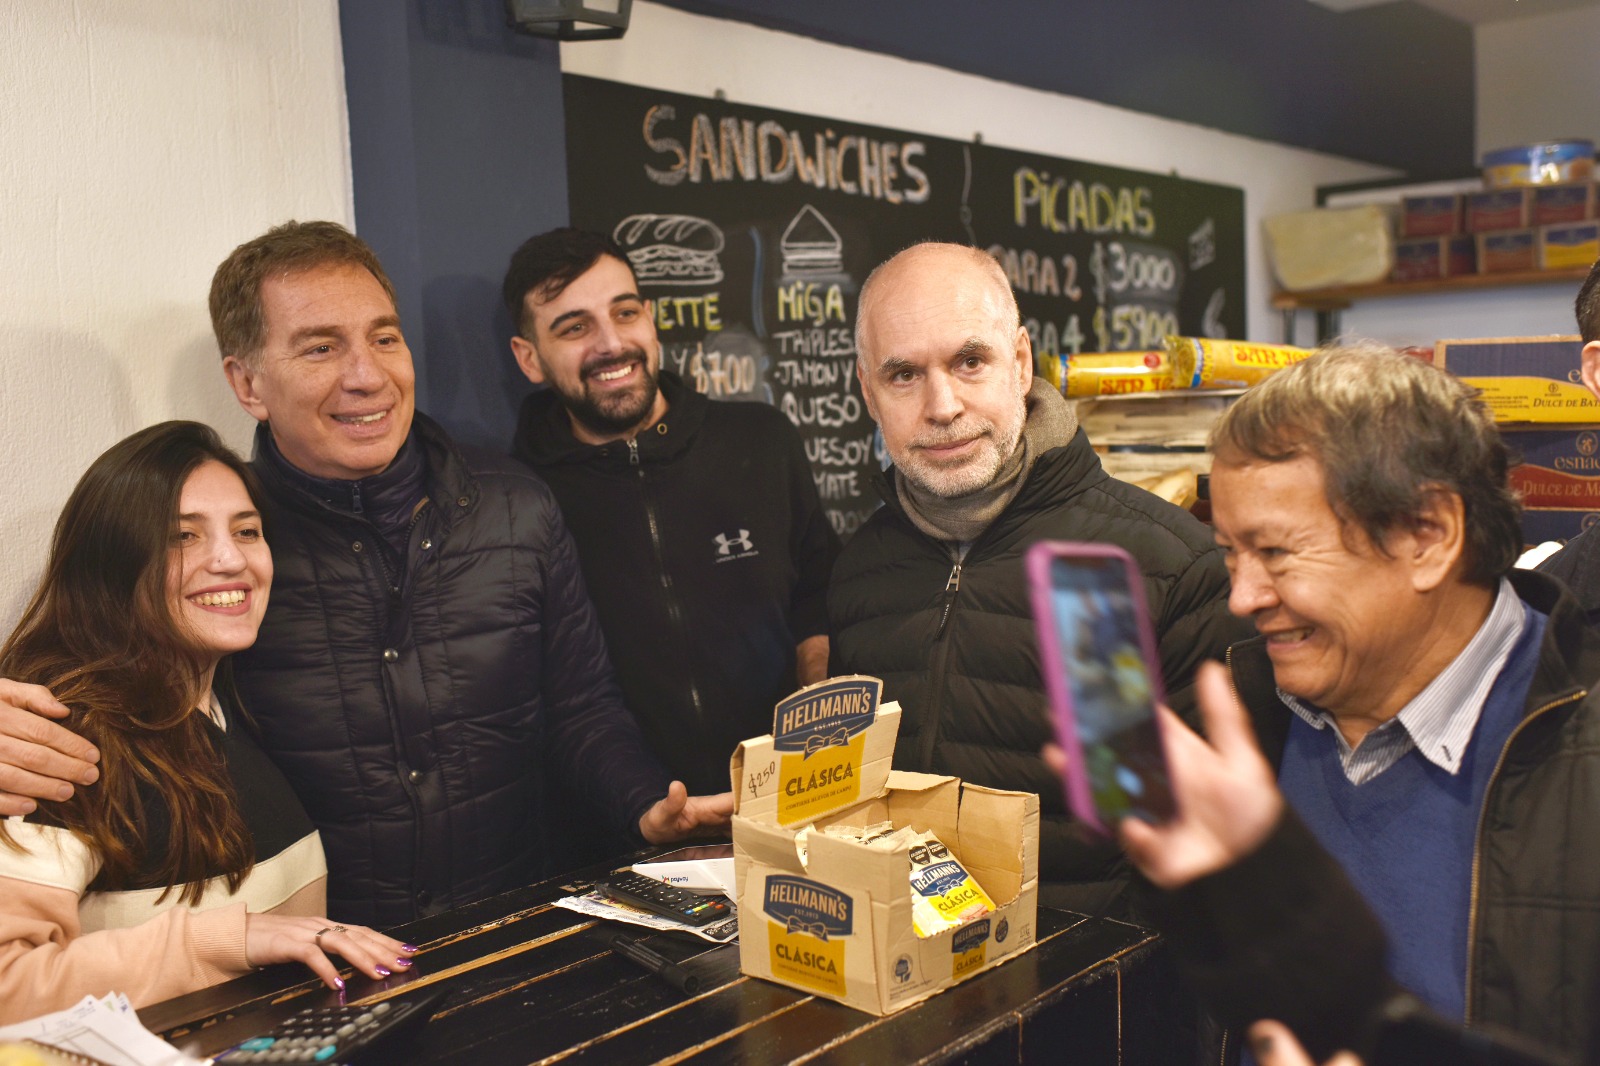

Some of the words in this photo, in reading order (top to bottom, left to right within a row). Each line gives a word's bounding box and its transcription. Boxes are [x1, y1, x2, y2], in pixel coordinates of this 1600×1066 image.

[1062, 253, 1082, 301] 2
[653, 291, 723, 331] ETTE
[1025, 316, 1059, 358] RA
[1061, 313, 1086, 353] 4
[780, 392, 861, 428] QUESO
[782, 686, 872, 735] HELLMANN'S
[748, 760, 776, 798] $250
[785, 761, 854, 796] CLÁSICA
[914, 863, 961, 891] HELLMANN'S
[769, 884, 848, 921] HELLMANN'S
[775, 943, 838, 975] CLÁSICA
